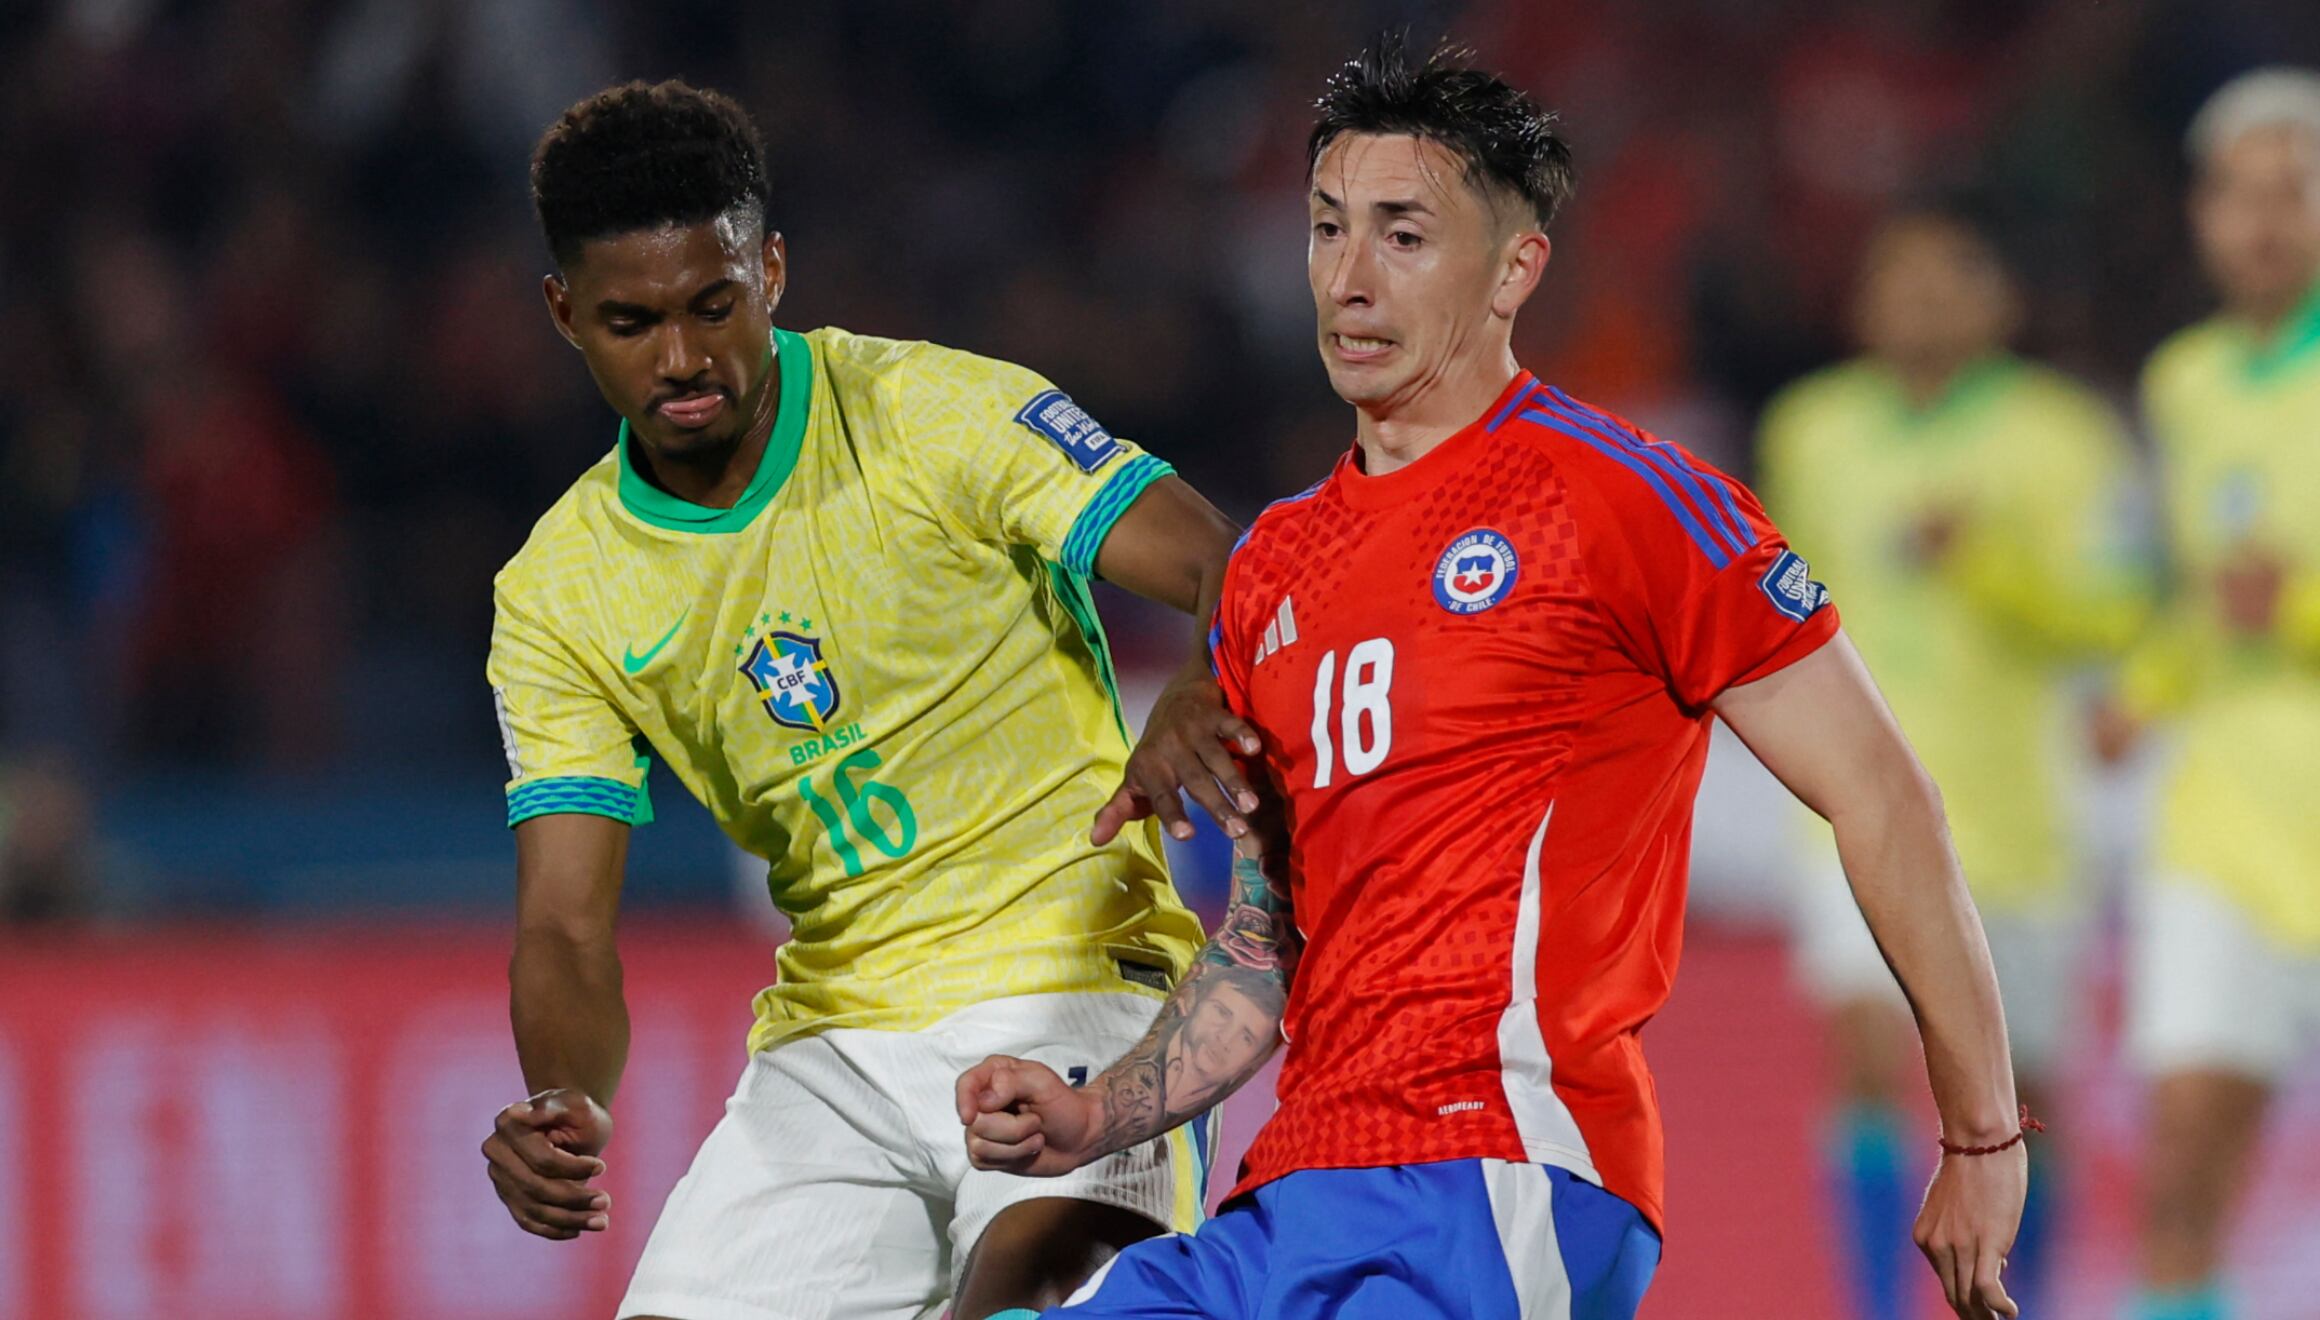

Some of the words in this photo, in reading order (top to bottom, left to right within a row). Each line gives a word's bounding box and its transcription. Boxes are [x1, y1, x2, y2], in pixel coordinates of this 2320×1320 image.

[1435, 534, 1478, 579] FEDERACION
[1483, 534, 1496, 546] DE
[1495, 540, 1516, 573] FUTBOL
[1776, 559, 1805, 594] FOOTBAL
[1449, 601, 1462, 612] DE
[1466, 598, 1494, 612] CHILE
[777, 669, 806, 691] CBF
[1311, 637, 1395, 788] 18
[788, 721, 868, 765] BRASIL
[797, 747, 918, 877] 16
